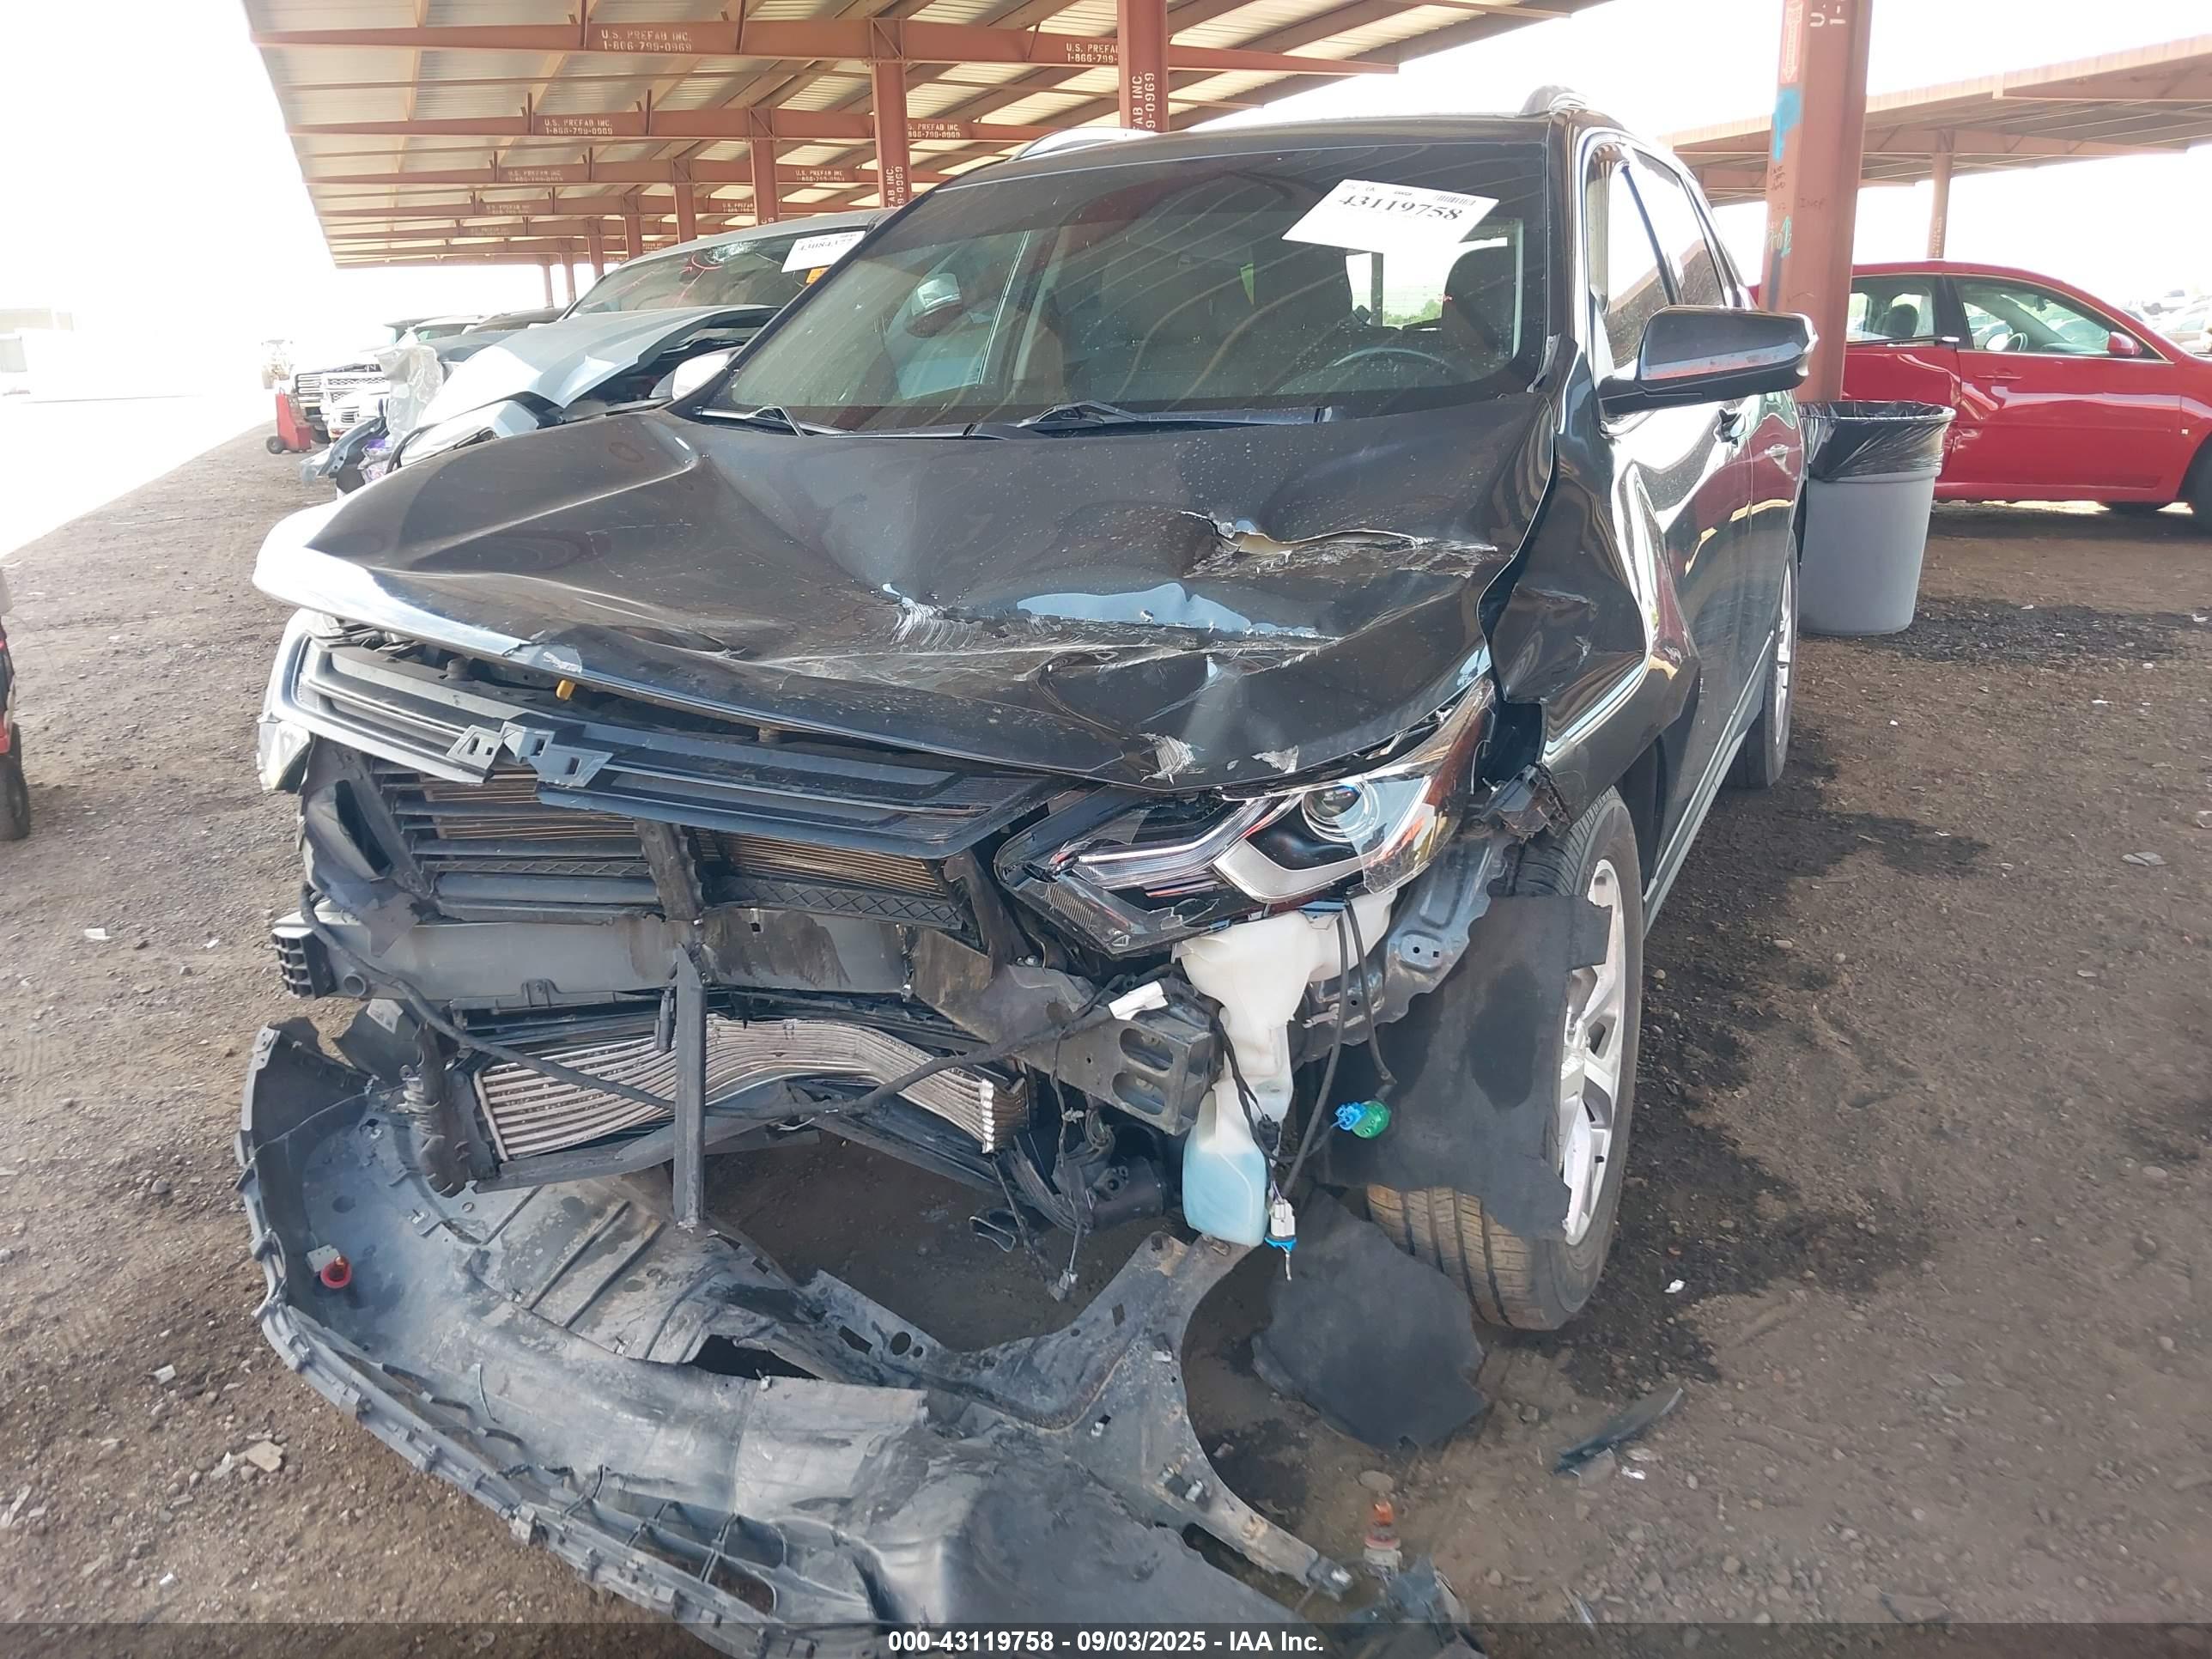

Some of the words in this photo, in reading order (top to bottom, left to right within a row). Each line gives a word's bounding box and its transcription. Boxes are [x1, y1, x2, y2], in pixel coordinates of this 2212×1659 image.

[627, 30, 667, 41] PREFAB
[1066, 43, 1083, 52] U.S.
[563, 118, 593, 127] PREFAB
[917, 123, 945, 131] PREFAB
[1339, 194, 1462, 221] 43119758
